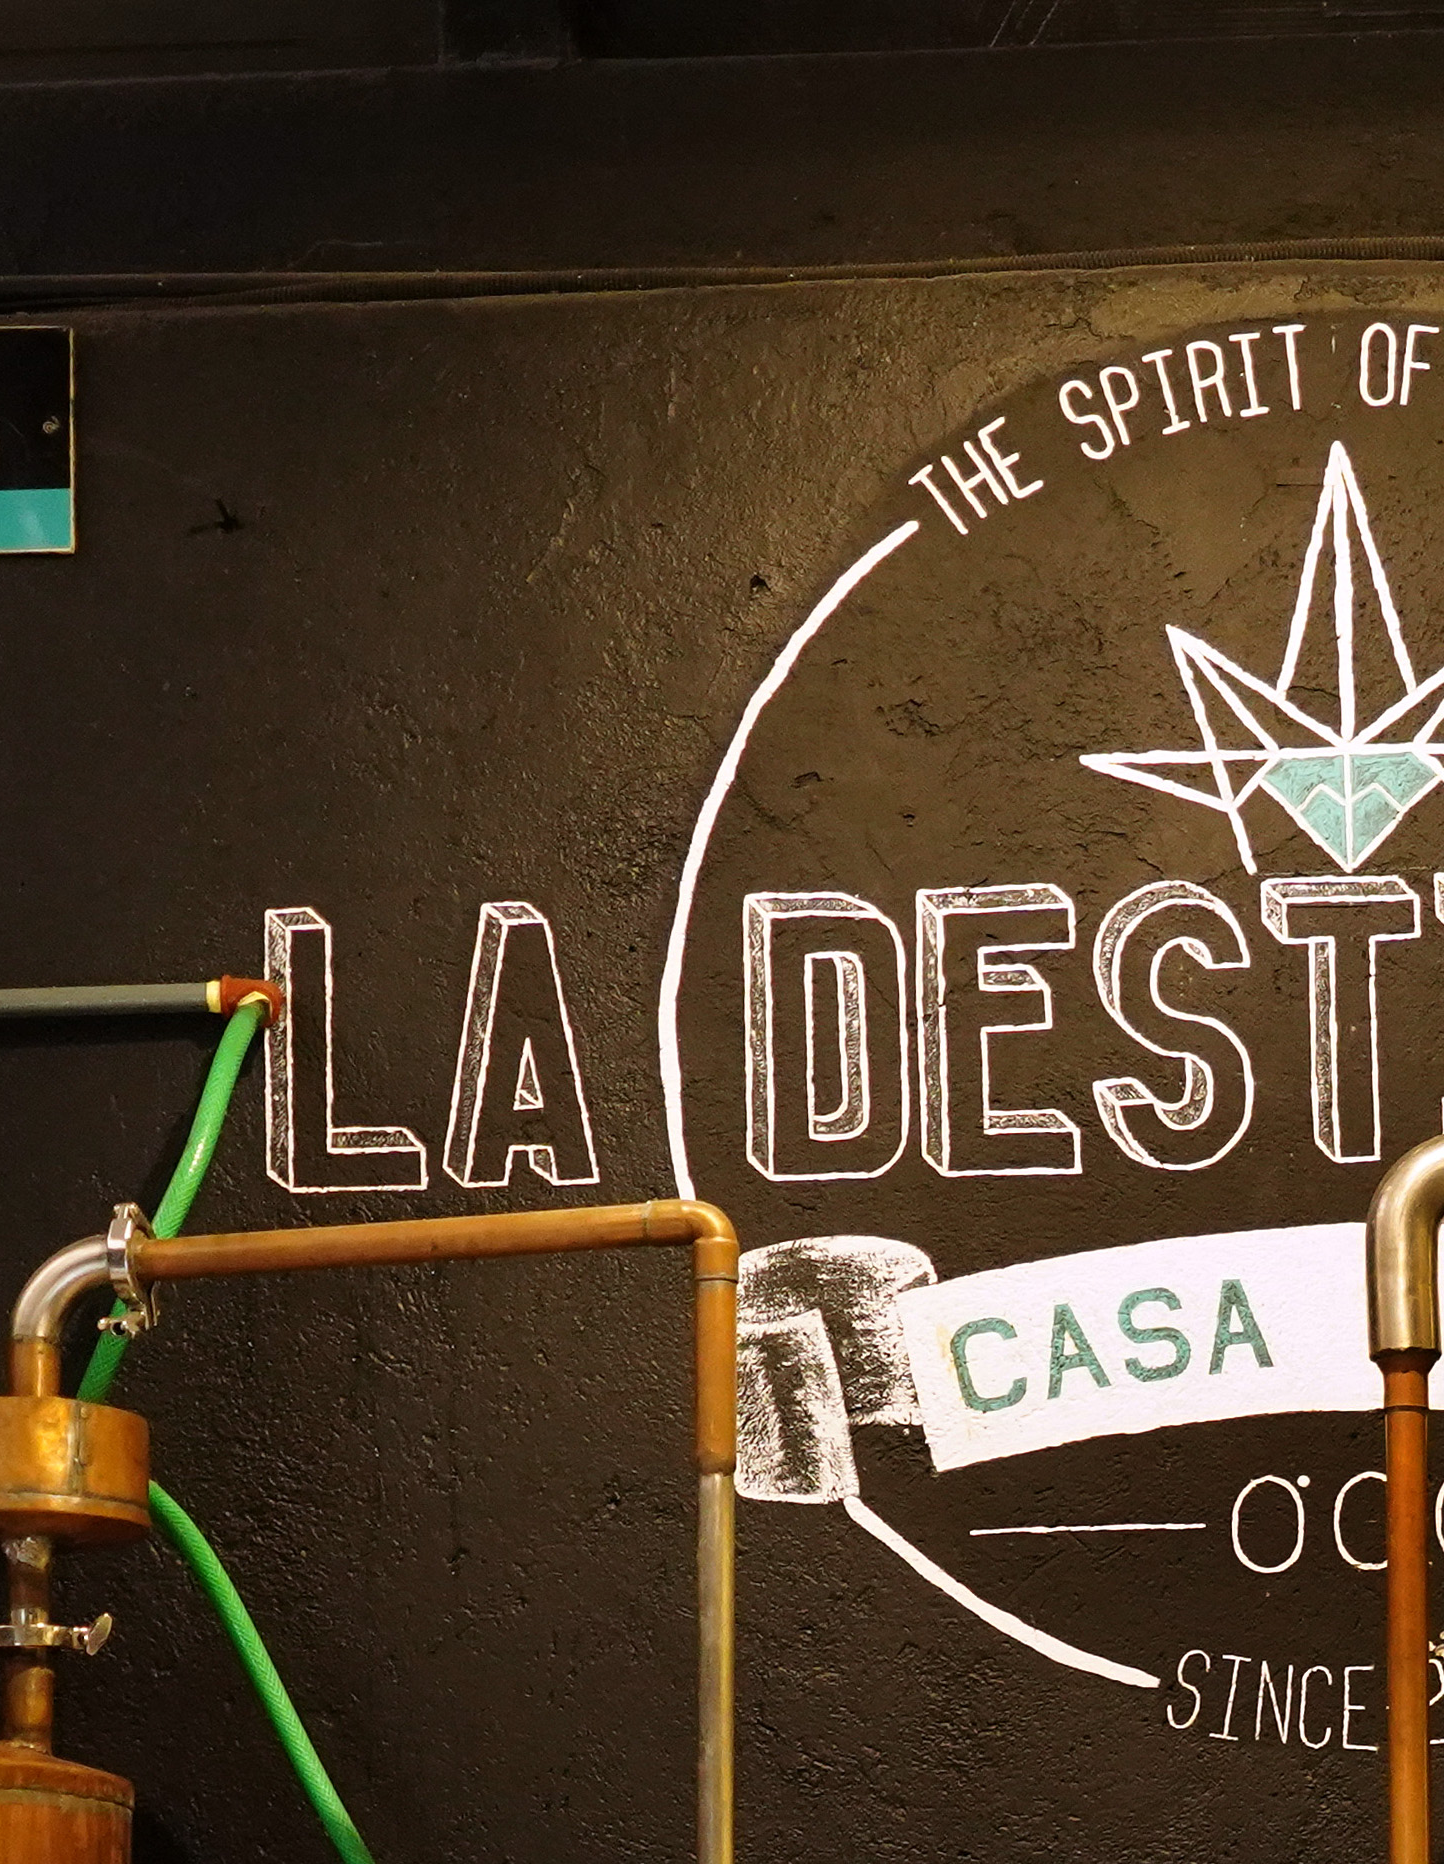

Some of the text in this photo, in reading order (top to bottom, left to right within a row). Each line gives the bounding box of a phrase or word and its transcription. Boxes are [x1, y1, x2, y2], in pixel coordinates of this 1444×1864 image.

[909, 418, 1044, 535] THE
[1058, 324, 1306, 461] SPIRIT
[1358, 322, 1441, 407] OF
[264, 900, 599, 1193] LA
[950, 1277, 1274, 1413] CASA
[1166, 1649, 1380, 1752] SINCE
